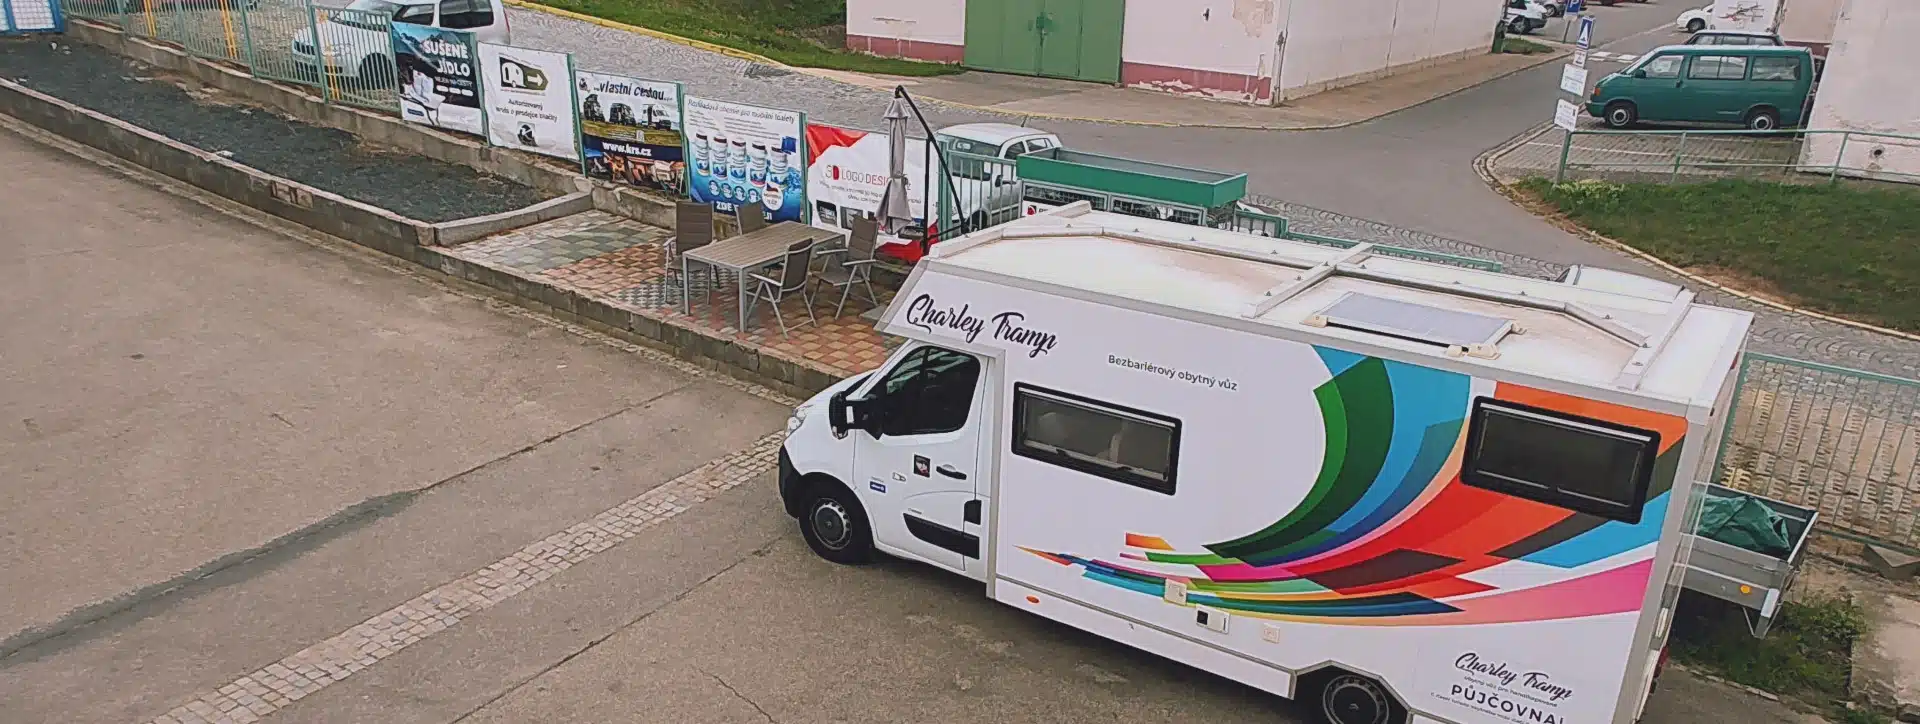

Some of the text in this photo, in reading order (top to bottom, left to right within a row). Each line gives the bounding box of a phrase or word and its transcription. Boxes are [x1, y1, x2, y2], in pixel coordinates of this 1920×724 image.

[423, 39, 469, 59] SUŠENÉ
[436, 57, 471, 77] JÍDLO
[601, 140, 652, 157] www.krs.cz
[841, 168, 865, 184] LOGO
[716, 201, 733, 212] ZDE
[906, 293, 1058, 358] Charley Tramp
[1108, 354, 1238, 391] Bezbariérový obytný vůz
[1454, 652, 1573, 702] Charley Tramp
